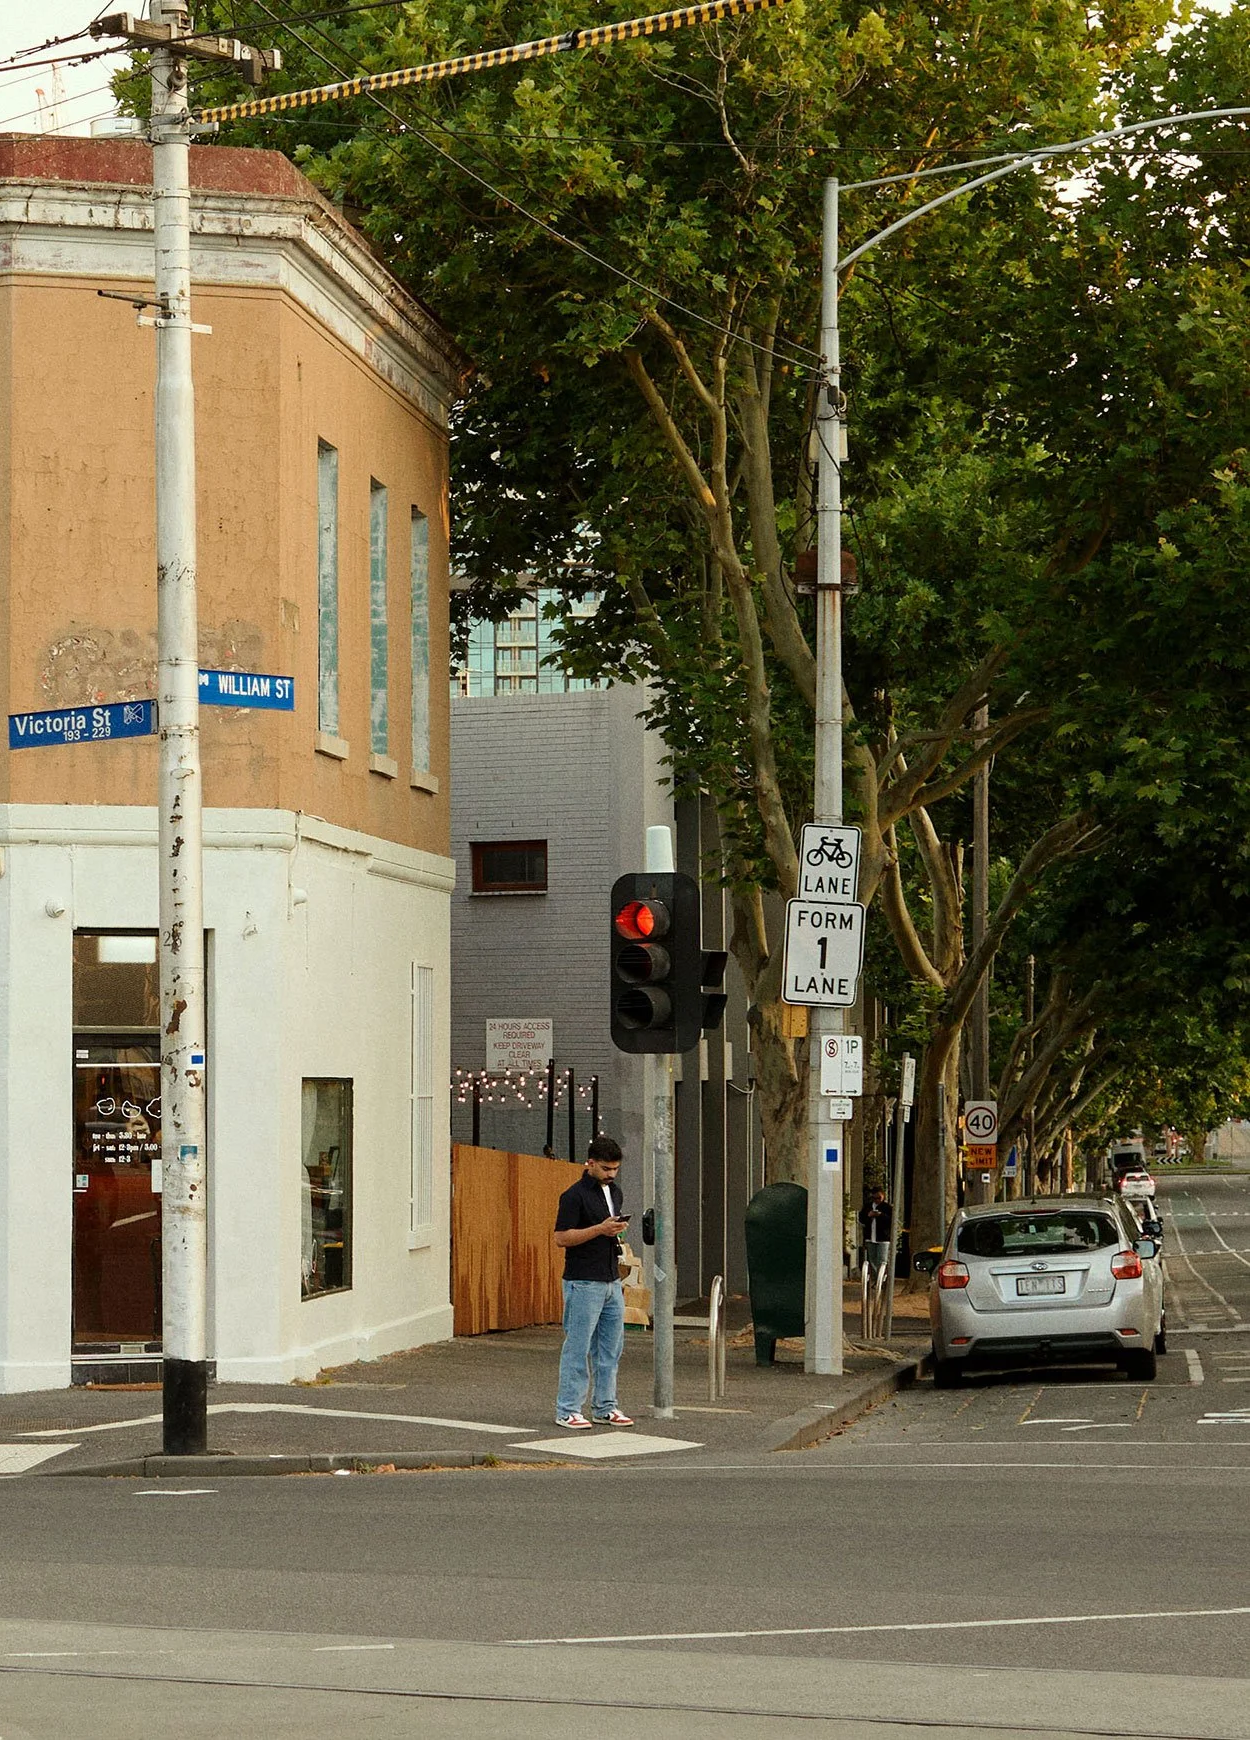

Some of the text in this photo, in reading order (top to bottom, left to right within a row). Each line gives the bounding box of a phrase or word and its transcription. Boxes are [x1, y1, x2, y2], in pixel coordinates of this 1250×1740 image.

[218, 674, 291, 699] WILLIAM ST
[14, 708, 111, 736] Victoria St
[63, 728, 81, 742] 193
[92, 726, 111, 739] 229
[804, 875, 851, 895] LANE
[797, 910, 853, 930] FORM
[817, 936, 828, 970] 1
[794, 975, 849, 995] LANE
[489, 1021, 550, 1031] 24 HOURS ACCESS
[503, 1031, 536, 1039] REQUIRED
[846, 1040, 859, 1054] 1P
[497, 1059, 505, 1067] AT
[523, 1059, 542, 1067] TIMES
[969, 1114, 993, 1130] 40
